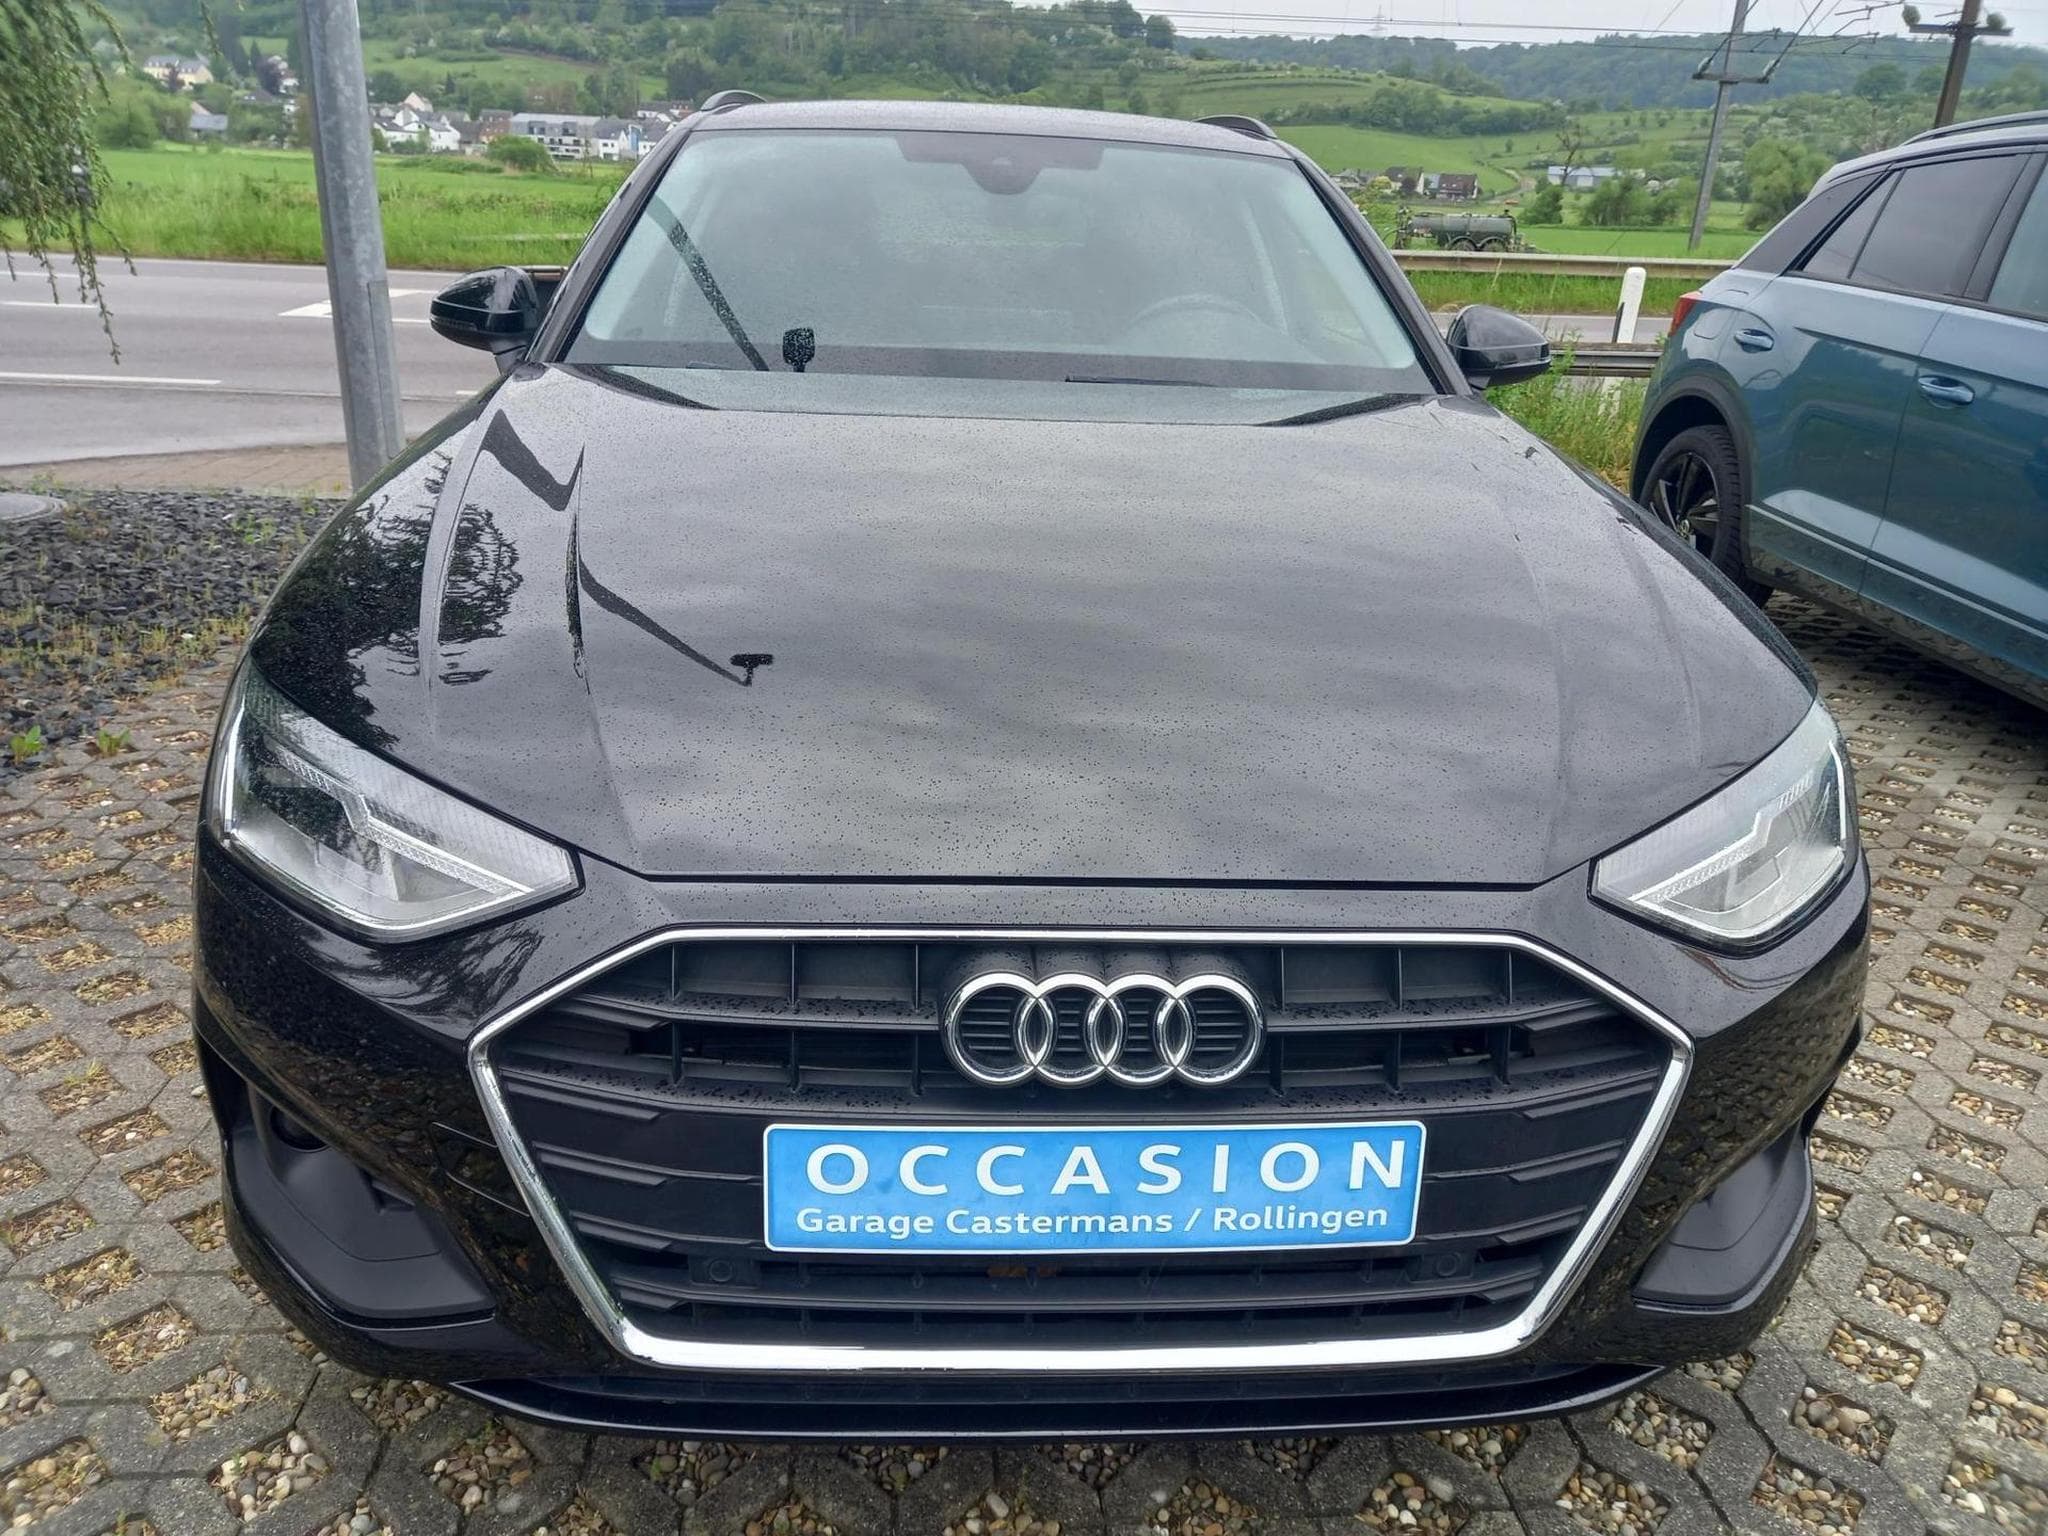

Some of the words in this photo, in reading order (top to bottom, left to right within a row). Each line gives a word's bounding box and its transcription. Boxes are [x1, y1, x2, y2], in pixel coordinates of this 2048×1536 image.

[806, 1140, 1405, 1196] OCCASION
[796, 1207, 935, 1240] Garage
[946, 1208, 1173, 1234] Castermans
[1184, 1207, 1203, 1232] /
[1213, 1204, 1388, 1235] Rollingen
